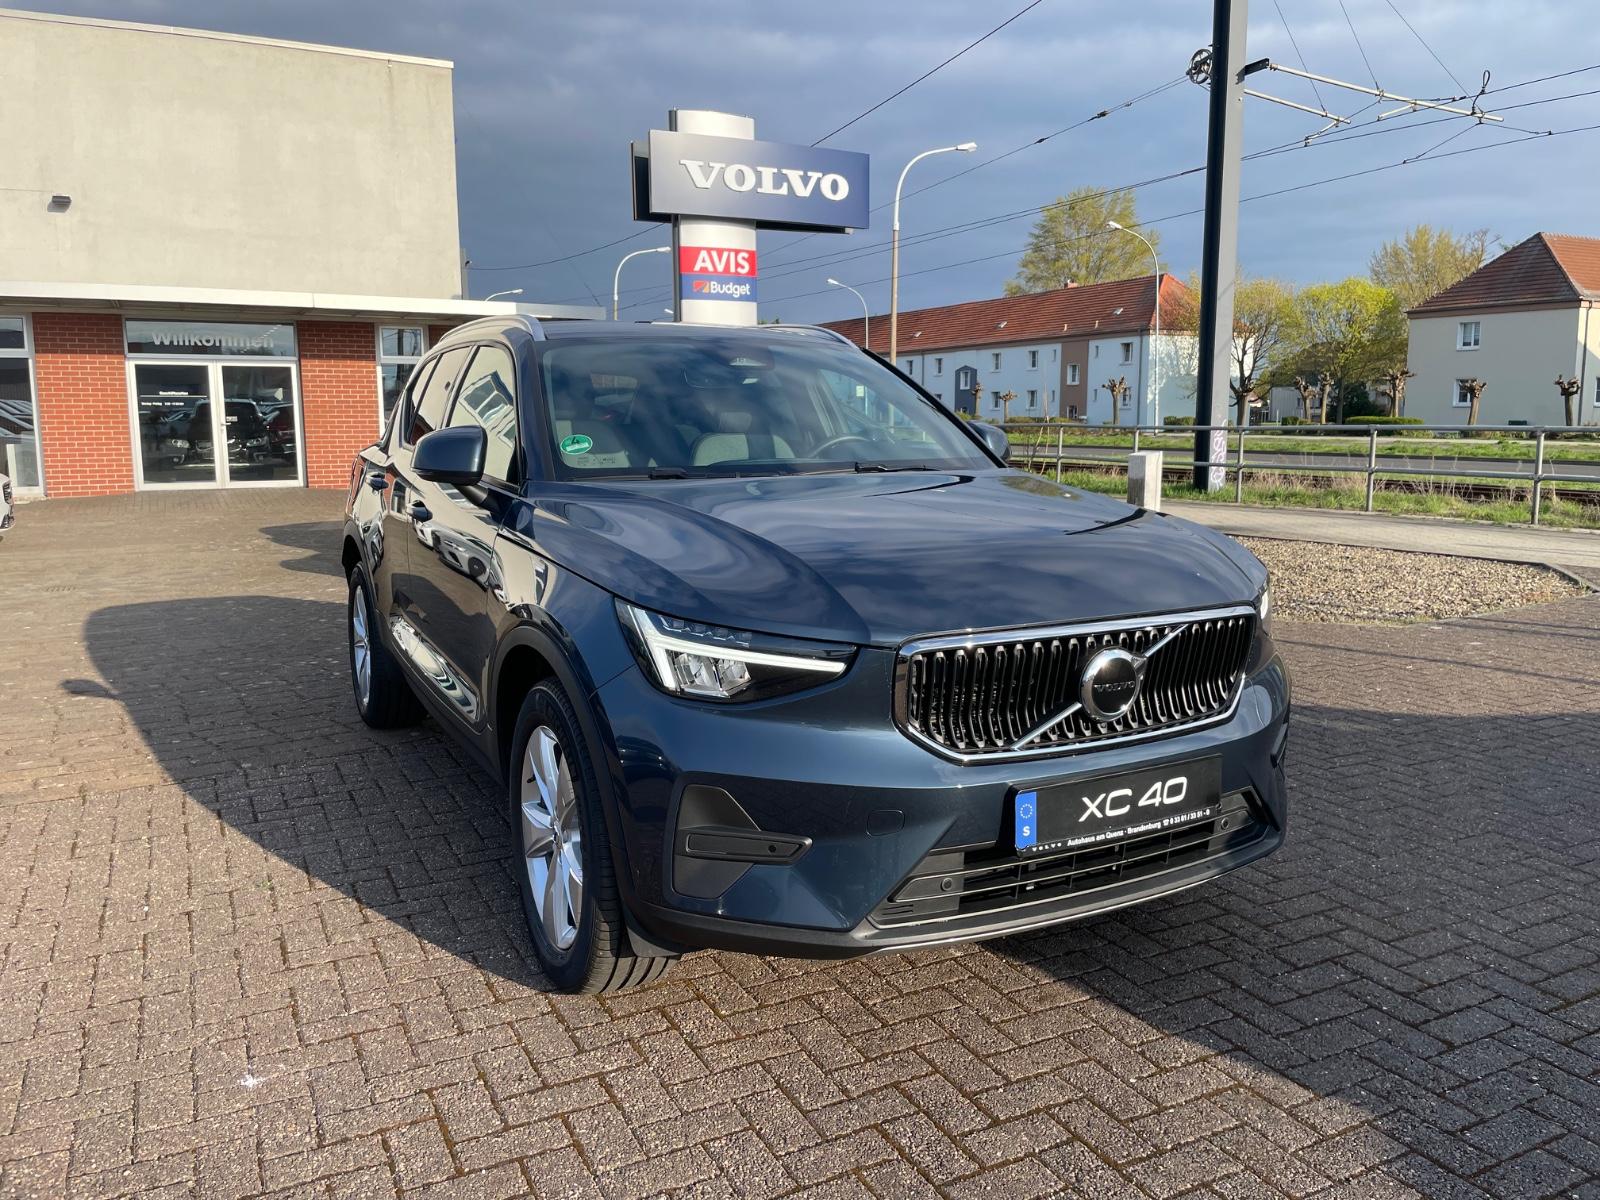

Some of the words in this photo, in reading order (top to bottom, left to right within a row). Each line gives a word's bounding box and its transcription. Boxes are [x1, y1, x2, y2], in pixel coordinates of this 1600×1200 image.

[679, 159, 849, 201] VOLVO
[693, 250, 750, 274] AVIS
[710, 281, 751, 298] Budget
[152, 332, 274, 348] Willkommen
[1093, 680, 1136, 692] VOLVO
[1078, 788, 1133, 823] XC
[1138, 776, 1188, 807] 40
[1022, 825, 1031, 837] S
[1032, 842, 1062, 852] VOLVO
[1067, 835, 1096, 847] Autohaus
[1127, 821, 1162, 834] Brandenburg
